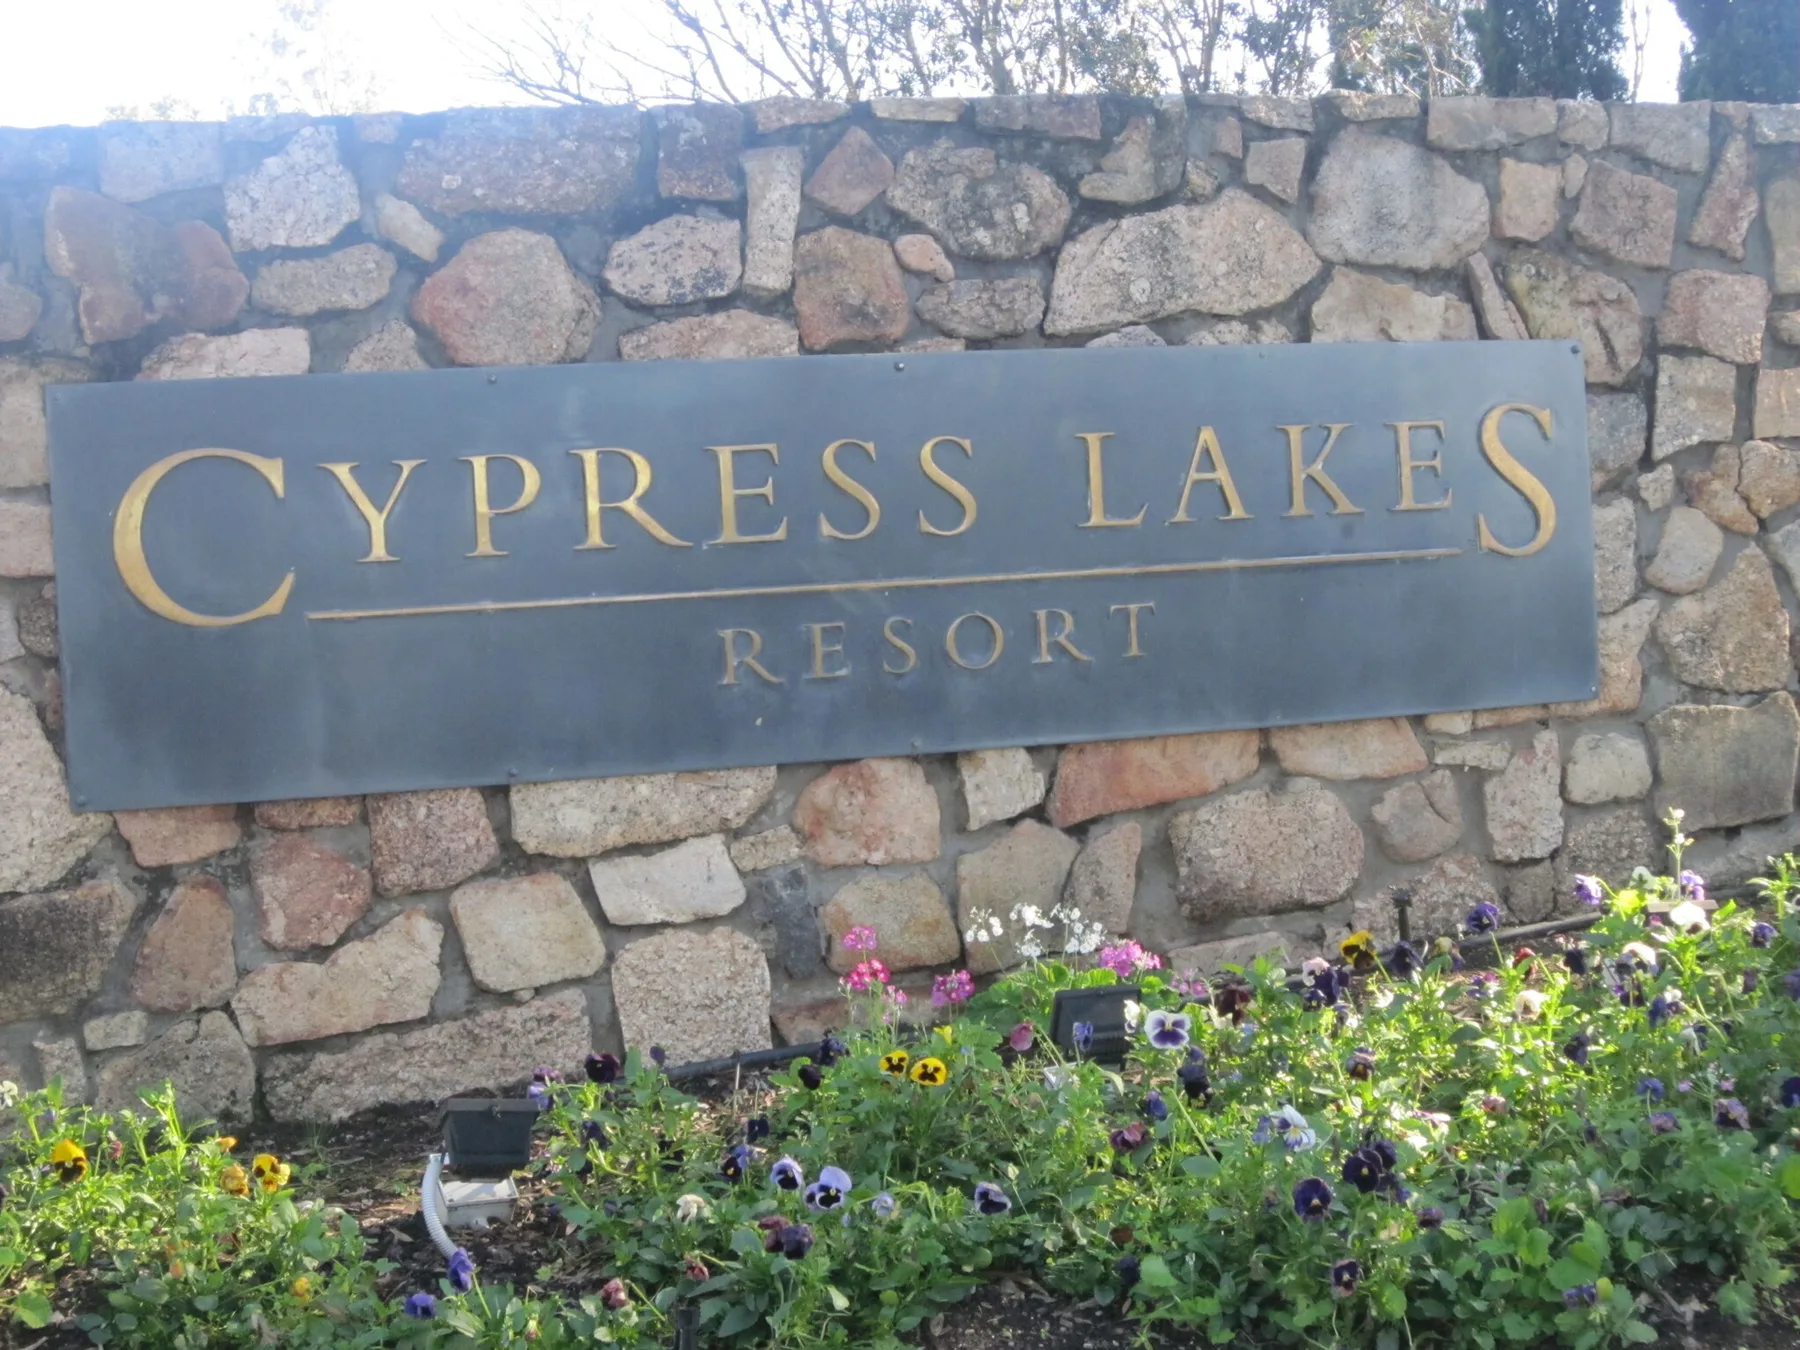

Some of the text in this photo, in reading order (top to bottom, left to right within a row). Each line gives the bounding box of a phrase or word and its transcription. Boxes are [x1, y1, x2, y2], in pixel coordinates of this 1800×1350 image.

[112, 402, 1558, 628] CYPRESS LAKES
[718, 602, 1158, 687] RESORT
